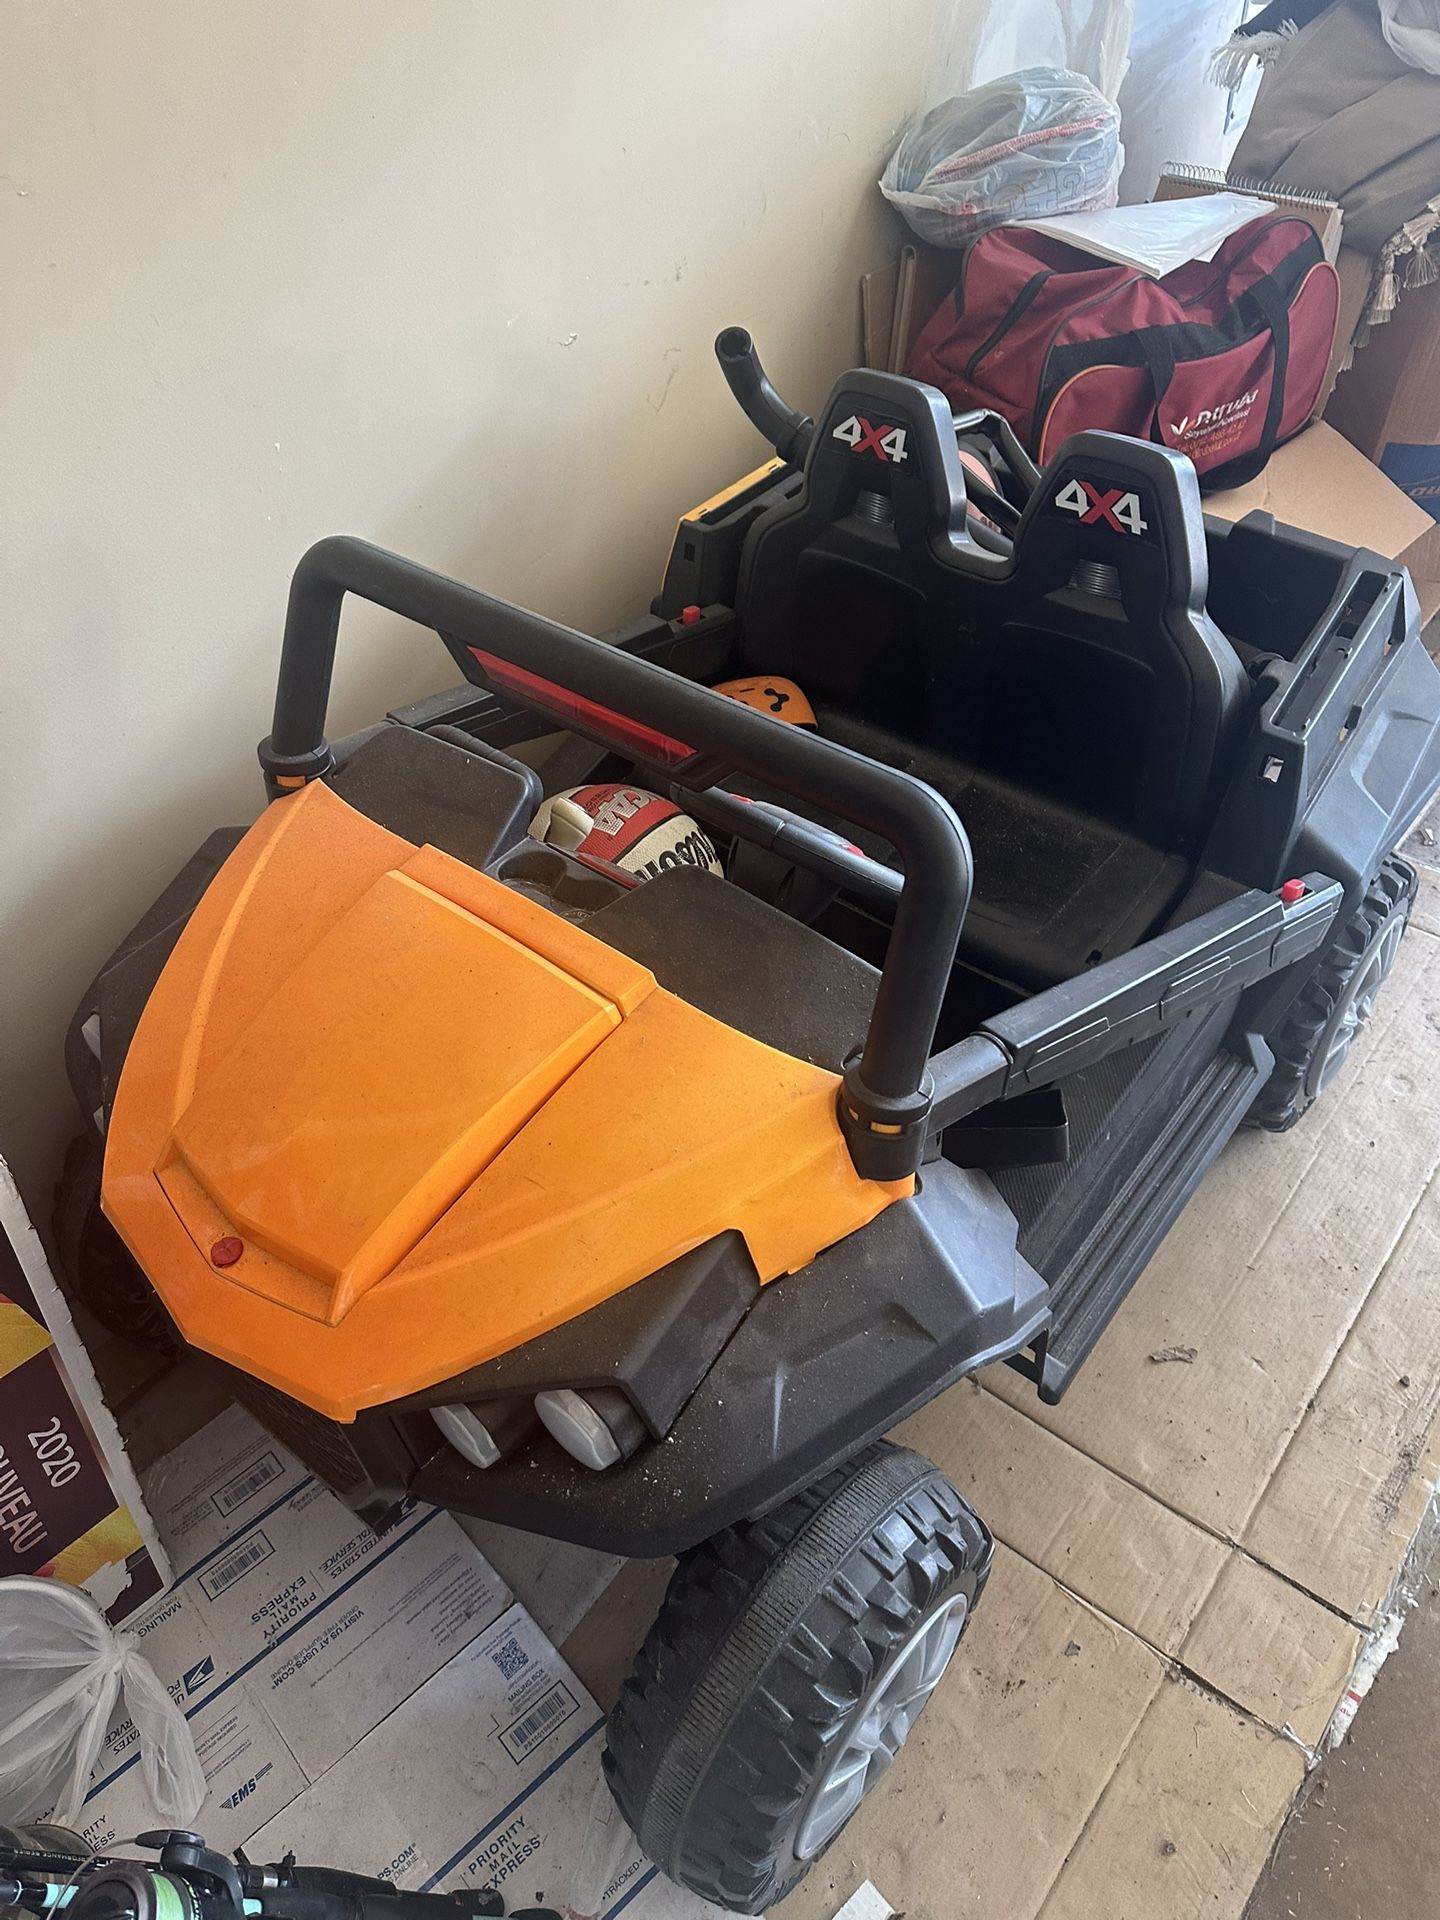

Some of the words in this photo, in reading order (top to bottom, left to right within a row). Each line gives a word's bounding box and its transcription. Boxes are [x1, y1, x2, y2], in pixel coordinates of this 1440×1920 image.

[833, 415, 908, 463] 4X4
[1055, 479, 1148, 535] 4X4
[594, 789, 656, 836] CAA
[28, 1416, 81, 1487] 2020
[0, 1445, 48, 1553] VEAU
[354, 1526, 372, 1543] TAL
[320, 1538, 358, 1571] SERVICE
[328, 1550, 362, 1579] STATES
[249, 1575, 307, 1624] EXPRESS
[259, 1590, 317, 1640] PRIORITY
[269, 1593, 299, 1620] MAIL
[136, 1600, 182, 1638] MAILING
[329, 1626, 343, 1640] US
[341, 1608, 365, 1629] VISIT
[317, 1637, 331, 1650] AT
[101, 1717, 135, 1746] RVICE
[110, 1728, 142, 1755] TATES
[227, 1777, 259, 1807] EMS
[81, 1814, 109, 1838] RITY
[88, 1832, 100, 1843] IL
[466, 1815, 529, 1875] PRIORITY
[487, 1838, 521, 1871] MAIL
[376, 1845, 415, 1881] PS.COM
[604, 1862, 640, 1898] TRACKED
